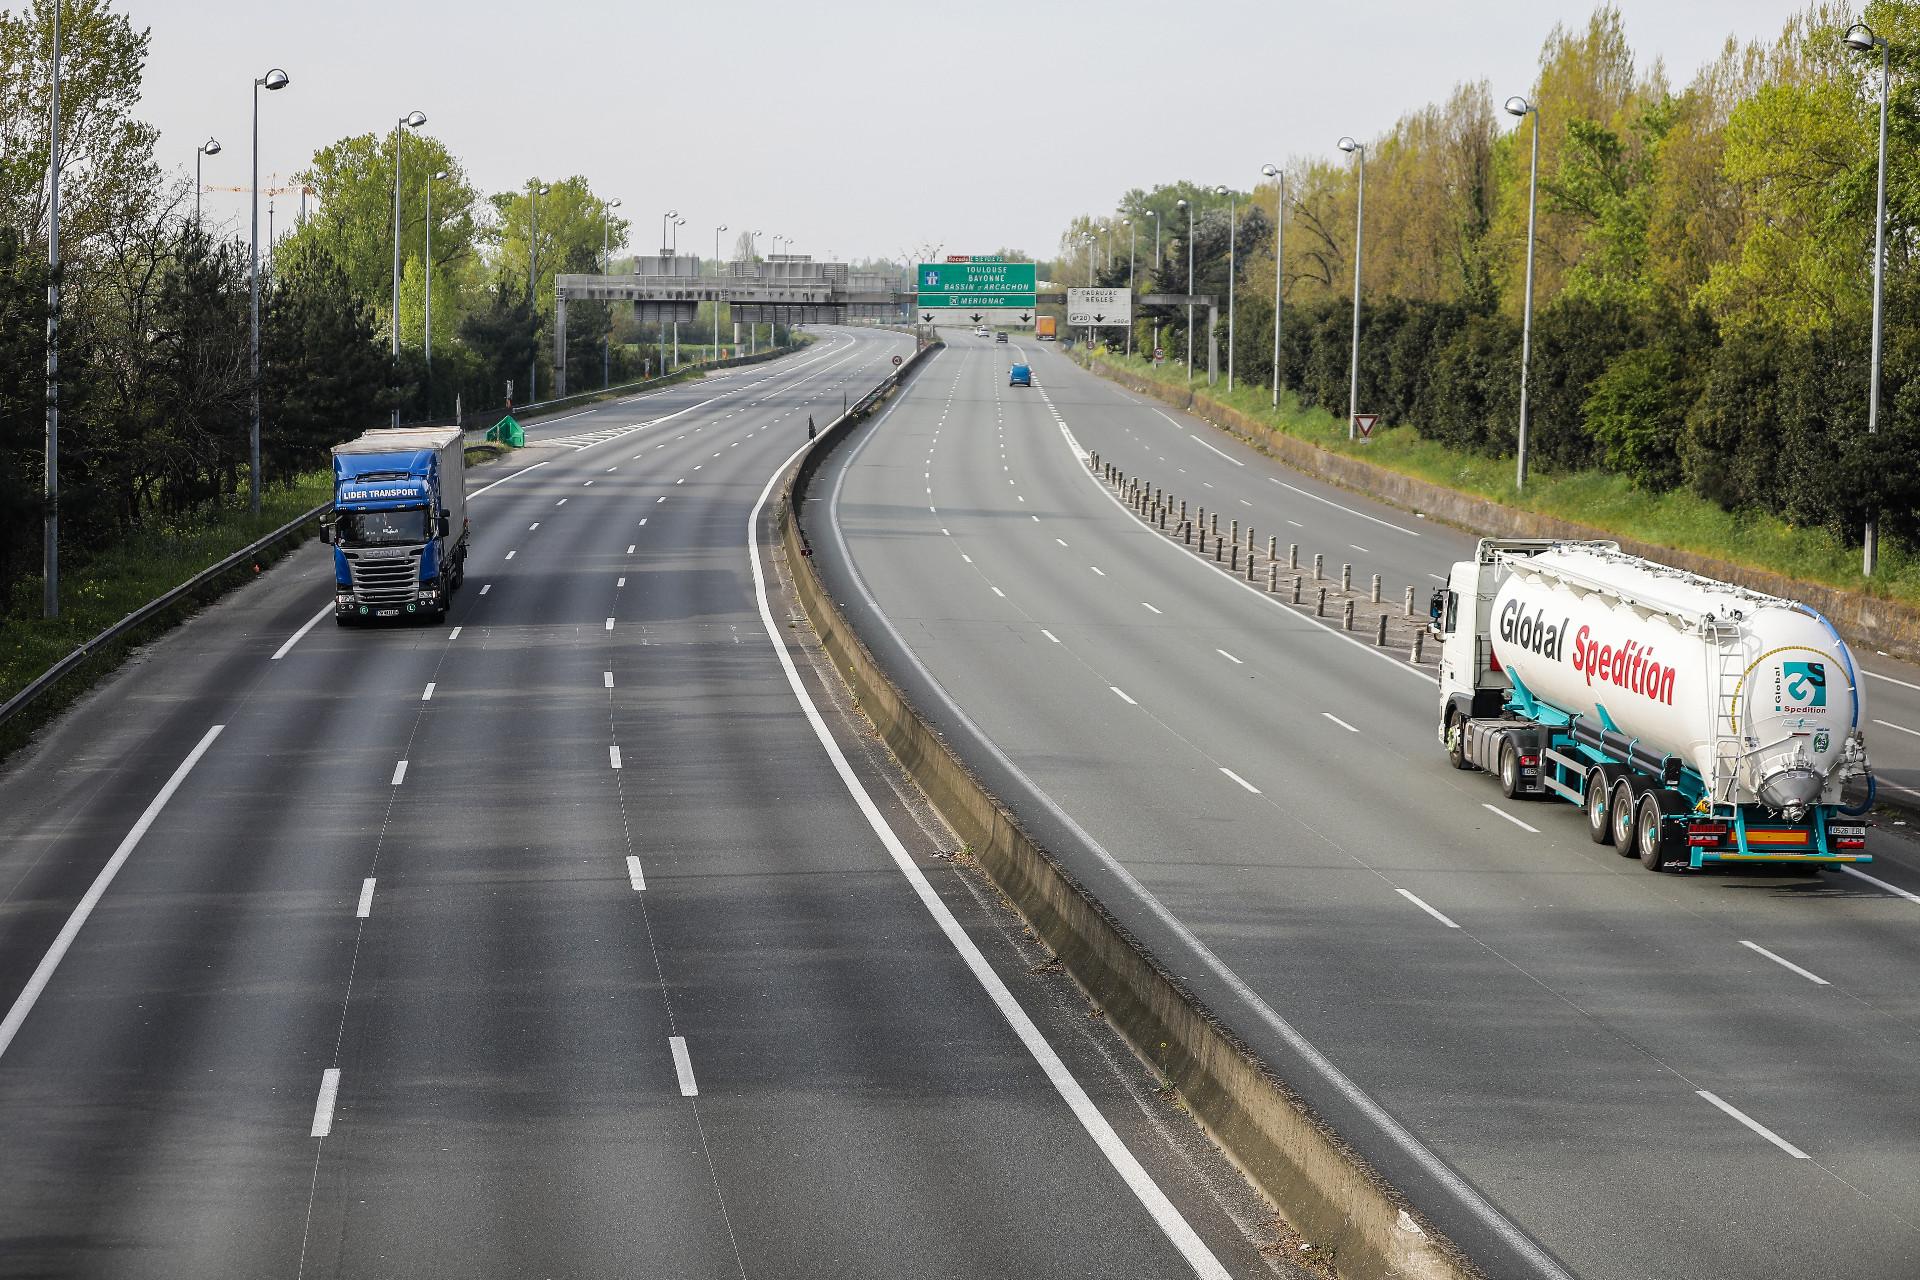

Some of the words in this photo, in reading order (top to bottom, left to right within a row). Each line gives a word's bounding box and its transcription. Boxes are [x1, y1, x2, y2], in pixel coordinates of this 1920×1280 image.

[967, 266, 1008, 274] TOULOUSE
[968, 274, 1005, 282] BAYONNE
[944, 283, 974, 291] BASSIN
[343, 490, 367, 500] LIDER
[369, 488, 418, 498] TRANSPORT
[366, 549, 401, 558] SCANIA
[1500, 598, 1570, 662] Global
[1573, 625, 1675, 706] Spedition
[1784, 705, 1826, 714] Spedition
